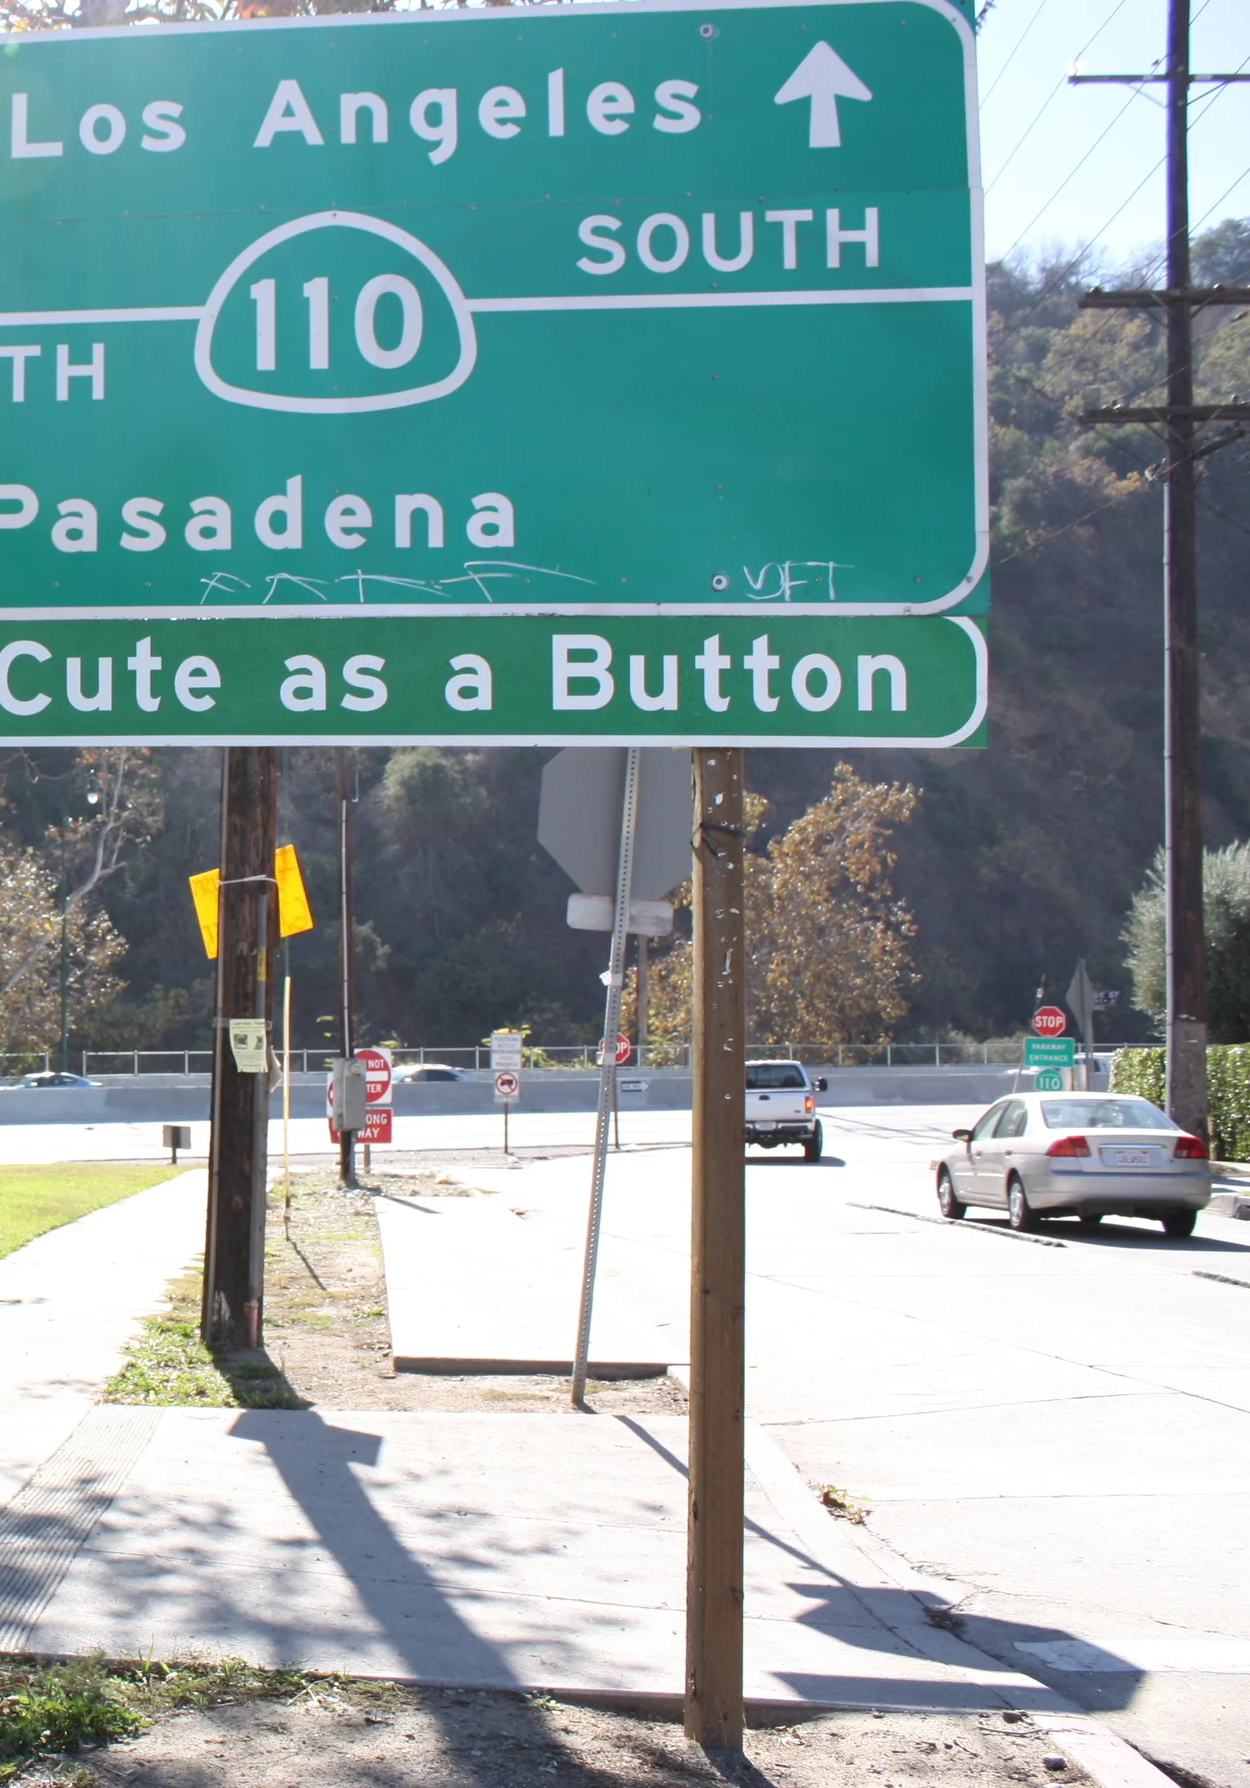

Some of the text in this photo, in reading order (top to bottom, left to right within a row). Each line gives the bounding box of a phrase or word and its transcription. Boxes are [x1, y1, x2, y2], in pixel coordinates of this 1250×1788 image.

[11, 66, 701, 164] Los Angeles
[577, 207, 879, 275] SOUTH
[251, 273, 423, 371] 110
[279, 654, 388, 712] as
[444, 653, 493, 712] a
[552, 632, 907, 713] Button
[1034, 1016, 1064, 1028] STOP
[367, 1059, 385, 1069] NOT
[365, 1083, 383, 1093] TER
[1039, 1078, 1060, 1090] 110
[365, 1114, 388, 1125] ONG
